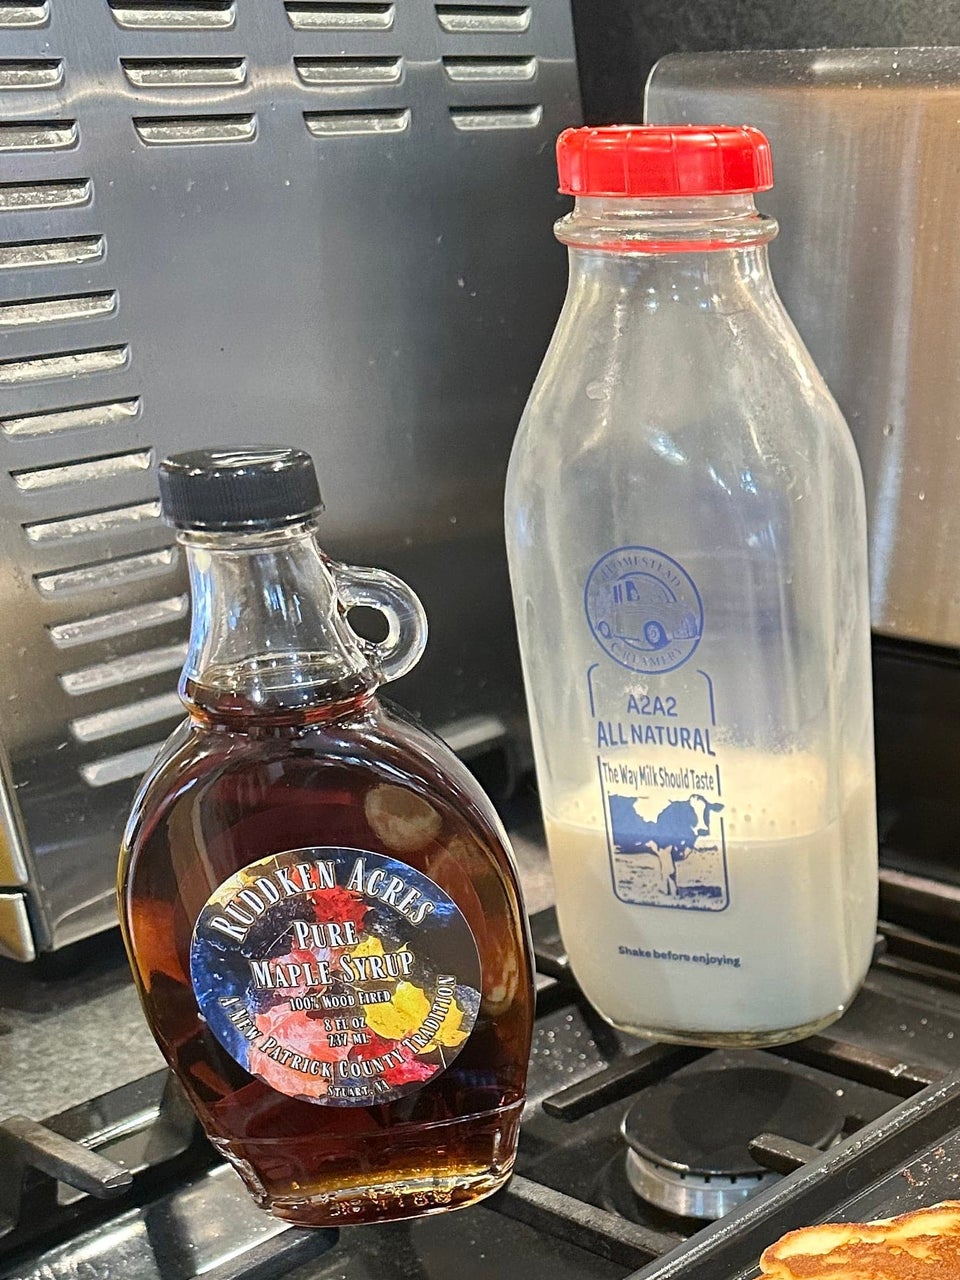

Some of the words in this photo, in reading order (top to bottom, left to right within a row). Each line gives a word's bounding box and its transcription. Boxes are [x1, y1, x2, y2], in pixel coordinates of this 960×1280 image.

[626, 694, 678, 717] A2A2
[598, 721, 628, 748] ALL
[630, 723, 716, 756] NATURAL
[602, 762, 620, 784] The
[619, 764, 639, 790] Way
[639, 764, 659, 787] Milk
[659, 766, 690, 788] Should
[689, 769, 715, 791] Taste
[209, 860, 336, 943] RUDDKEN
[348, 857, 435, 926] ACRES
[294, 920, 360, 950] PURE
[251, 960, 334, 990] MAPLE
[340, 951, 415, 983] SYRUP
[618, 945, 651, 958] Shake
[653, 948, 691, 962] before
[692, 953, 741, 968] enjoying
[219, 996, 240, 1007] A
[290, 996, 320, 1011] 100%
[322, 994, 355, 1009] WOOD
[359, 990, 391, 1005] FIRED
[402, 975, 457, 1054] TRADITION
[228, 1009, 263, 1041] NEW
[323, 1018, 332, 1031] 8
[335, 1019, 348, 1031] FL
[352, 1017, 366, 1029] OZ
[328, 1034, 348, 1047] 237
[352, 1032, 369, 1044] ML
[259, 1037, 332, 1078] PATRICK
[339, 1048, 405, 1078] COUNTY
[374, 1079, 390, 1091] VA
